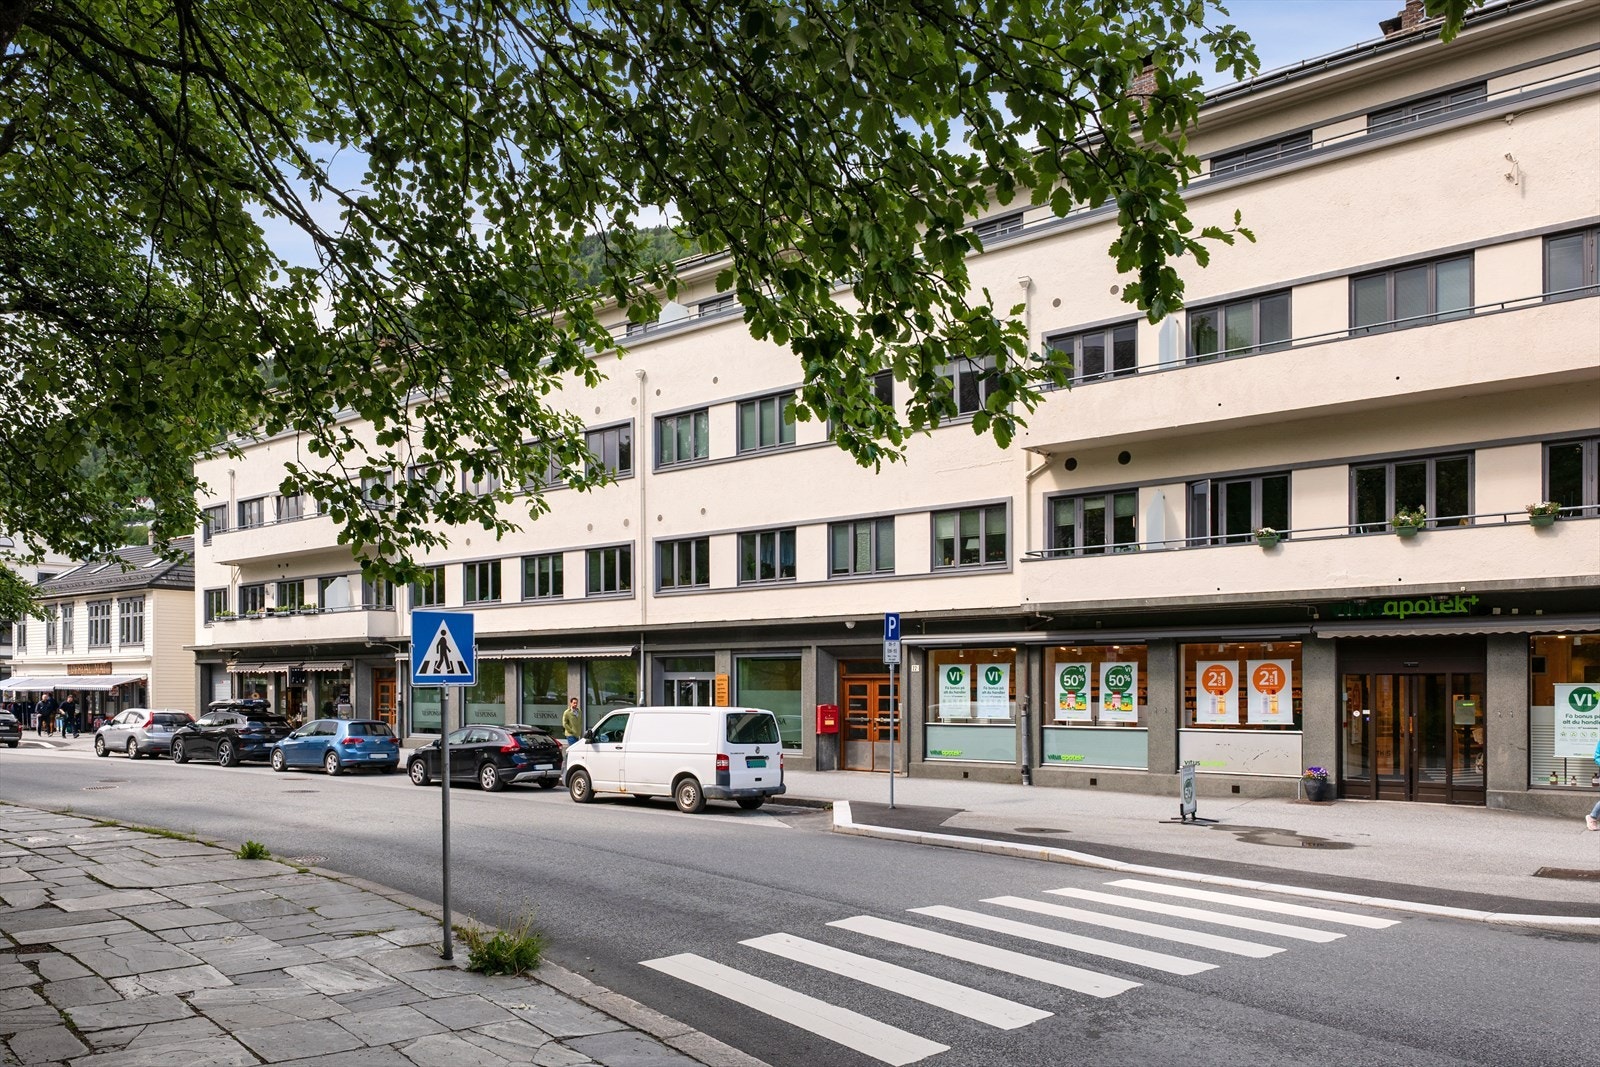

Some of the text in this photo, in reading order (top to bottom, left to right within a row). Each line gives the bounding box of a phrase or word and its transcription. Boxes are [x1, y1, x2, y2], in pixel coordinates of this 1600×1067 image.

[888, 616, 896, 637] P
[949, 672, 960, 680] VI
[987, 672, 998, 680] VI
[1064, 674, 1084, 686] 50%
[1108, 674, 1130, 686] 50%
[1208, 672, 1218, 686] 2
[1259, 671, 1269, 685] 2
[1573, 694, 1592, 706] VI
